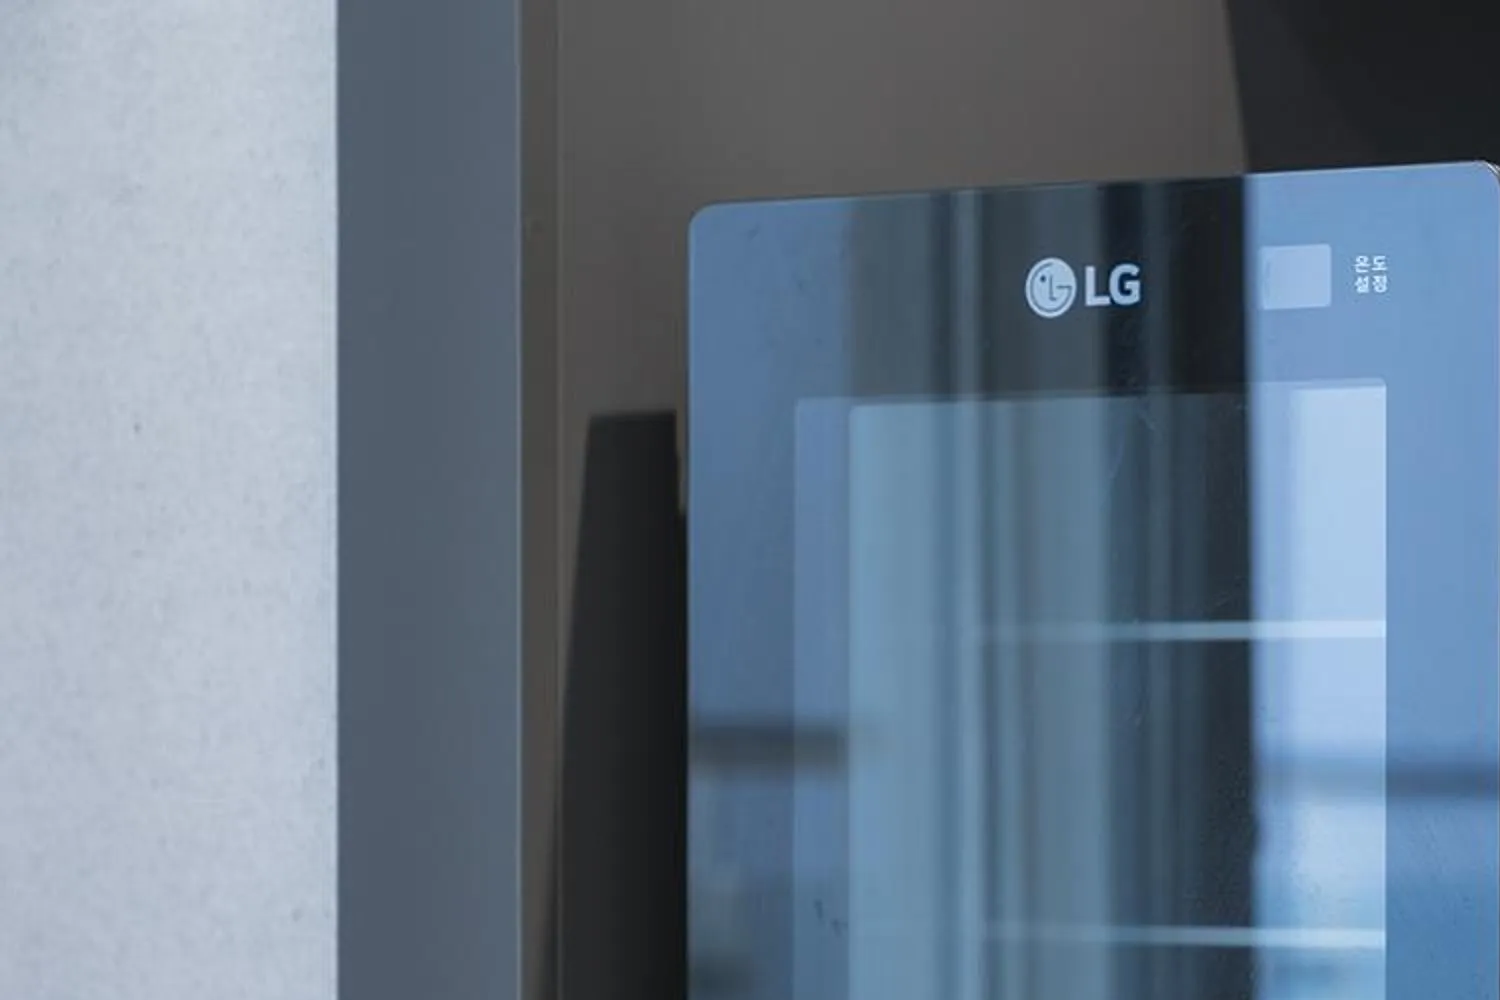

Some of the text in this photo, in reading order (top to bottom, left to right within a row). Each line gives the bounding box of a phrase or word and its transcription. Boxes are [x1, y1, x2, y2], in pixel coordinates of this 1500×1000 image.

[1353, 254, 1388, 273] 온도
[1084, 263, 1142, 307] LG
[1354, 274, 1389, 294] 설정
